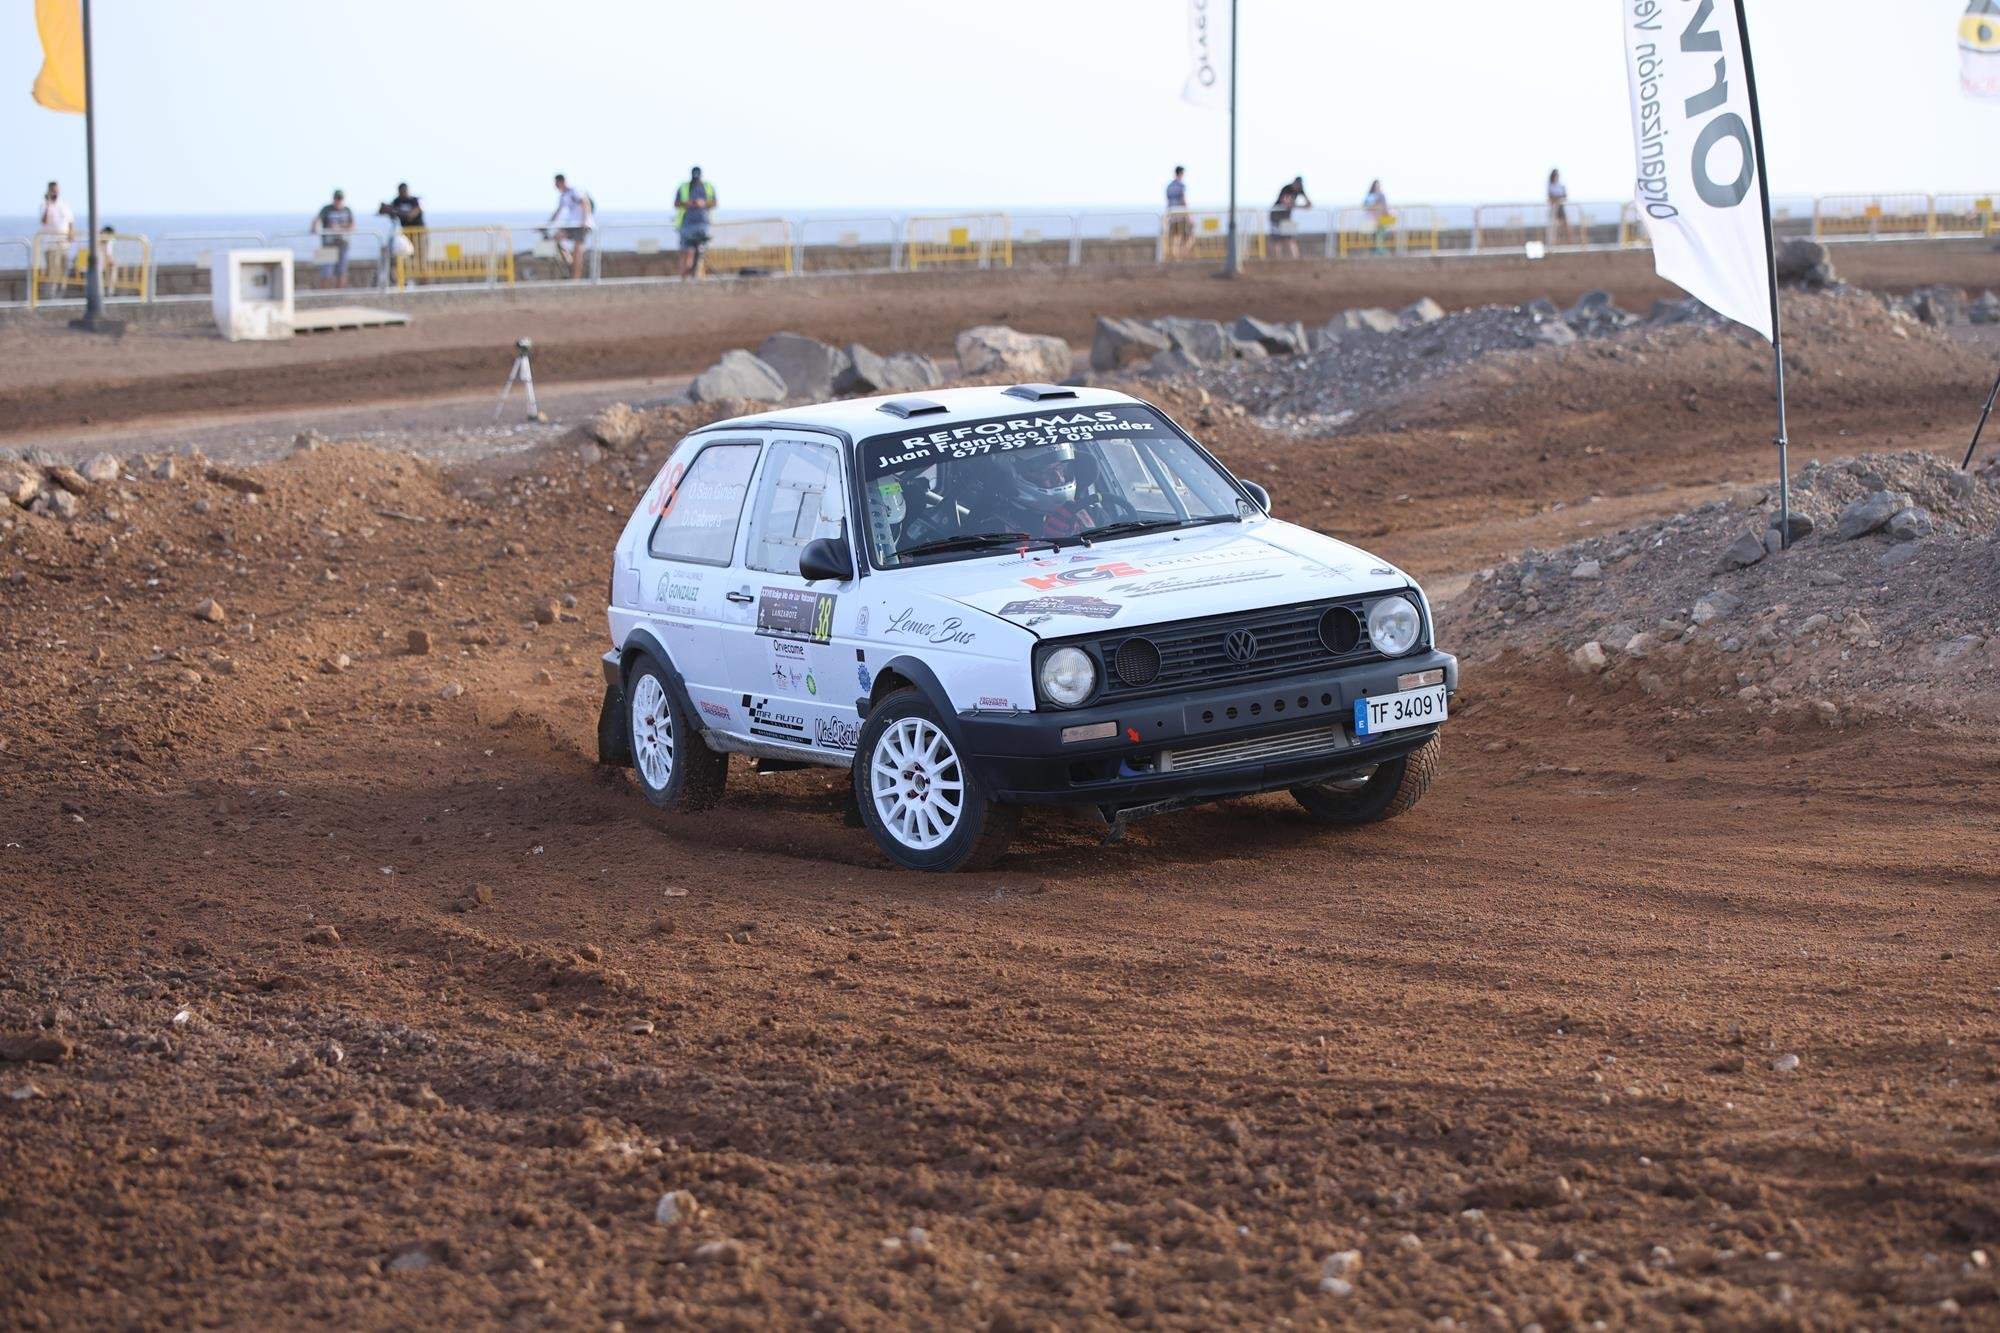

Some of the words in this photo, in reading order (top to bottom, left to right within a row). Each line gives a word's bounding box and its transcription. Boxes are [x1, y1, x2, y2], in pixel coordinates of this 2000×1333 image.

[877, 448, 931, 469] Juan
[935, 431, 1037, 453] Francisco
[1046, 420, 1154, 438] Fernández
[901, 411, 1118, 450] REFORMAS
[952, 446, 990, 459] 677
[1000, 439, 1025, 451] 39
[1035, 435, 1059, 447] 27
[1067, 431, 1094, 442] 03
[648, 462, 684, 519] 38
[771, 609, 798, 619] LANZAROTE
[815, 597, 832, 641] 38
[884, 607, 936, 636] Lemes
[929, 616, 976, 645] Bus
[773, 639, 804, 655] Orvecame
[775, 713, 804, 726] AUTO
[1370, 702, 1389, 724] TF
[1394, 695, 1432, 720] 3409
[1436, 692, 1445, 713] Y
[1359, 720, 1365, 729] E
